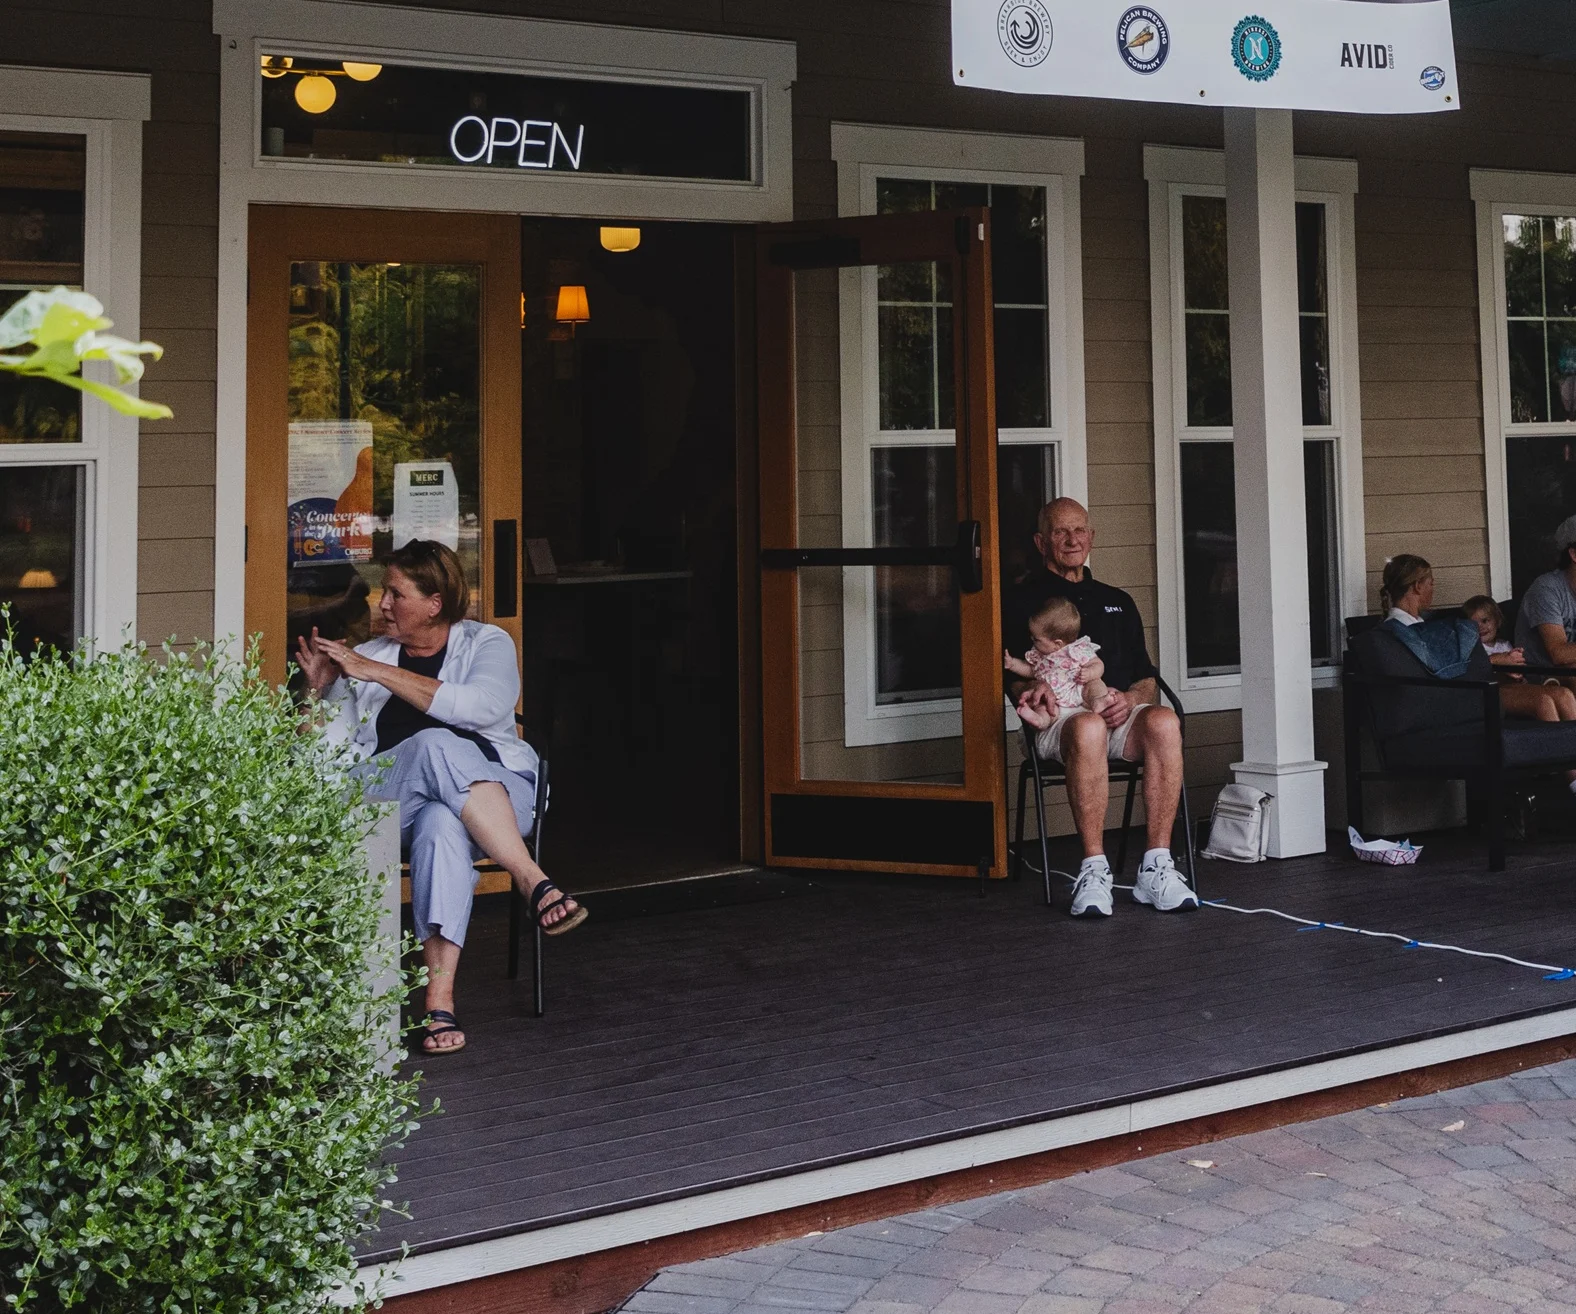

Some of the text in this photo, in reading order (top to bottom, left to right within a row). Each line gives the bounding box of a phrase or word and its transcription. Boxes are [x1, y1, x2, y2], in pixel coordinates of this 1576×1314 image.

[1119, 10, 1168, 45] PELICAN BREWING
[1249, 37, 1264, 60] N
[1340, 42, 1388, 69] AVID
[1388, 44, 1393, 52] CO
[1127, 57, 1161, 70] COMPANY
[451, 115, 585, 170] OPEN
[415, 473, 439, 482] MERC
[314, 522, 360, 540] Park
